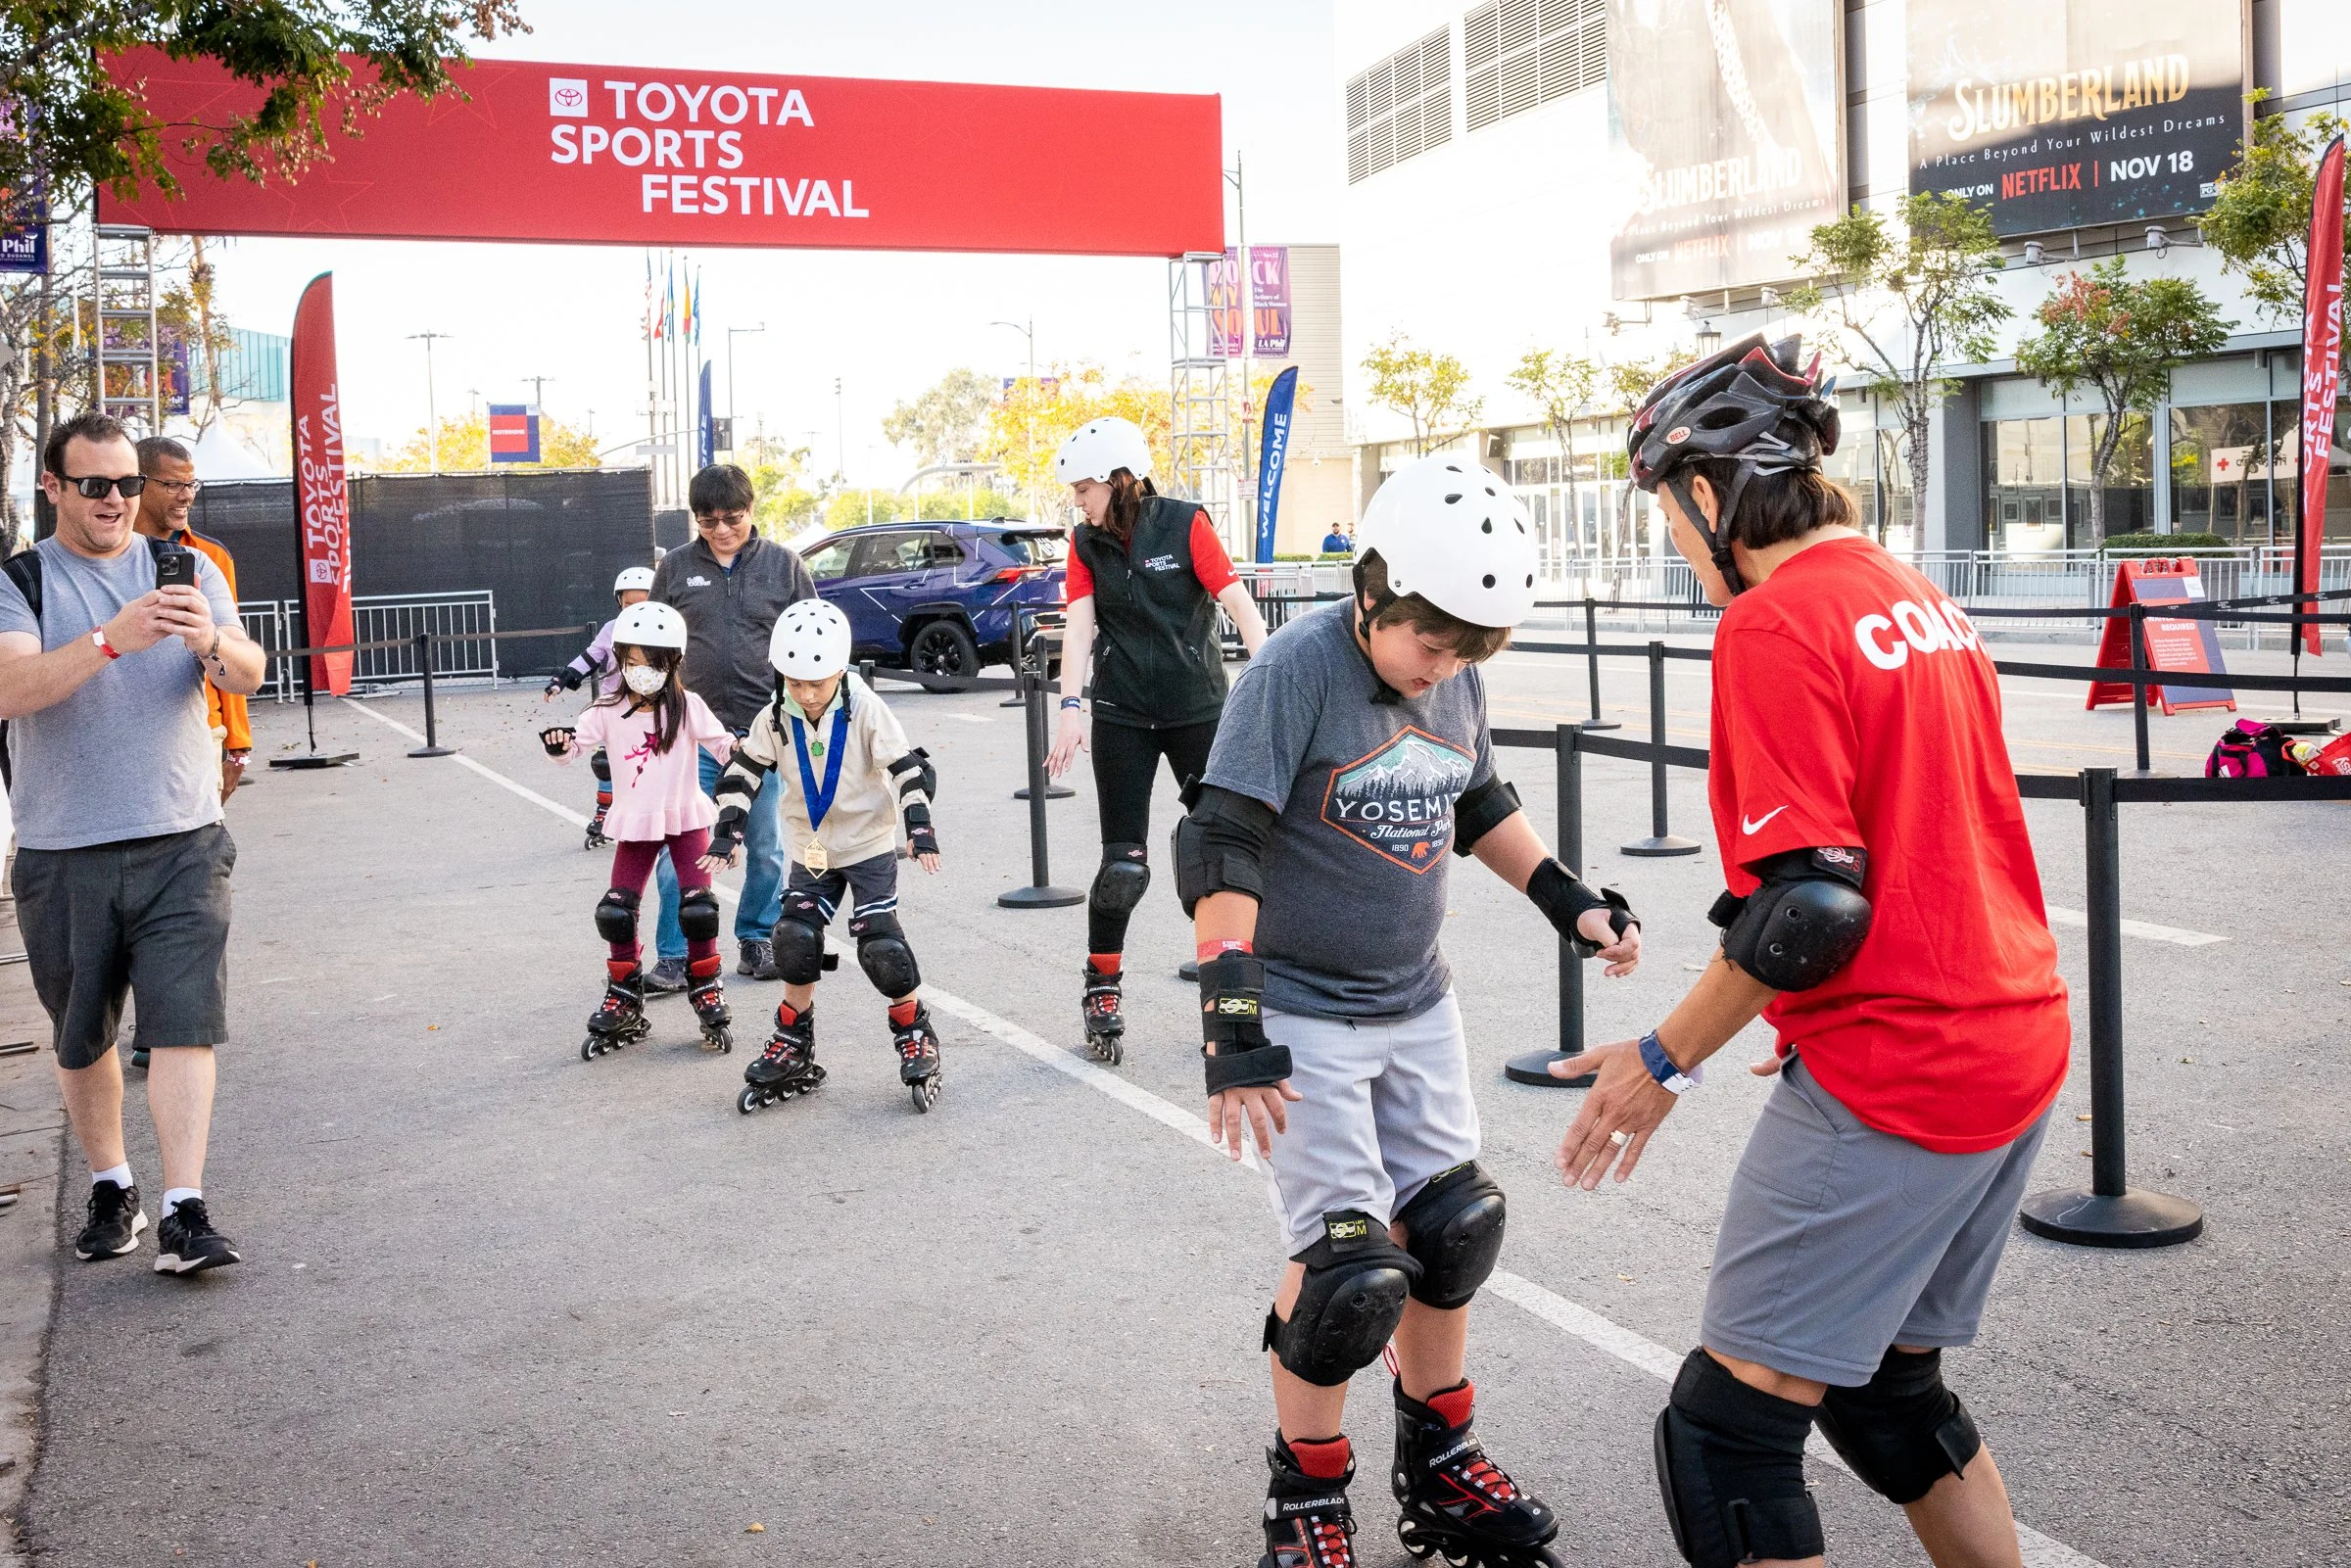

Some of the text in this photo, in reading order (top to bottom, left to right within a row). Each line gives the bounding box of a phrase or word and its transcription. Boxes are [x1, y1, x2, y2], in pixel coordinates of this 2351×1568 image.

[603, 80, 815, 127] TOYOTA
[1947, 53, 2189, 142] SLUMBERLAND
[551, 123, 744, 169] SPORTS
[1919, 114, 2226, 170] A Place Beyond Your Wildest Dreams
[642, 173, 870, 217] FESTIVAL
[1637, 147, 1801, 214] SLUMBERLAND
[1976, 183, 1994, 197] ON
[2001, 161, 2083, 201] NETFLIX
[2110, 155, 2162, 182] NOV
[2168, 150, 2194, 174] 18
[1661, 216, 1700, 233] Beyond
[1704, 213, 1729, 224] Your
[1734, 205, 1778, 219] Wildest
[1784, 198, 1826, 212] Dreams
[2, 238, 35, 254] Phil
[1674, 235, 1729, 264] NETFLIX
[2315, 271, 2342, 458] FESTIVAL
[320, 383, 345, 534] FESTIVAL
[1669, 429, 1688, 443] BELL
[298, 414, 325, 549] TOYOTA
[1262, 413, 1287, 539] WELCOME
[314, 464, 342, 586] SPORTS
[1150, 554, 1174, 563] TOYOTA
[1854, 599, 1988, 670] COAC
[1335, 792, 1462, 823] YOSEMIT
[1370, 825, 1430, 838] National
[1249, 1004, 1257, 1015] M
[1357, 1224, 1367, 1235] M
[1282, 1497, 1345, 1511] ROLLERBLADE
